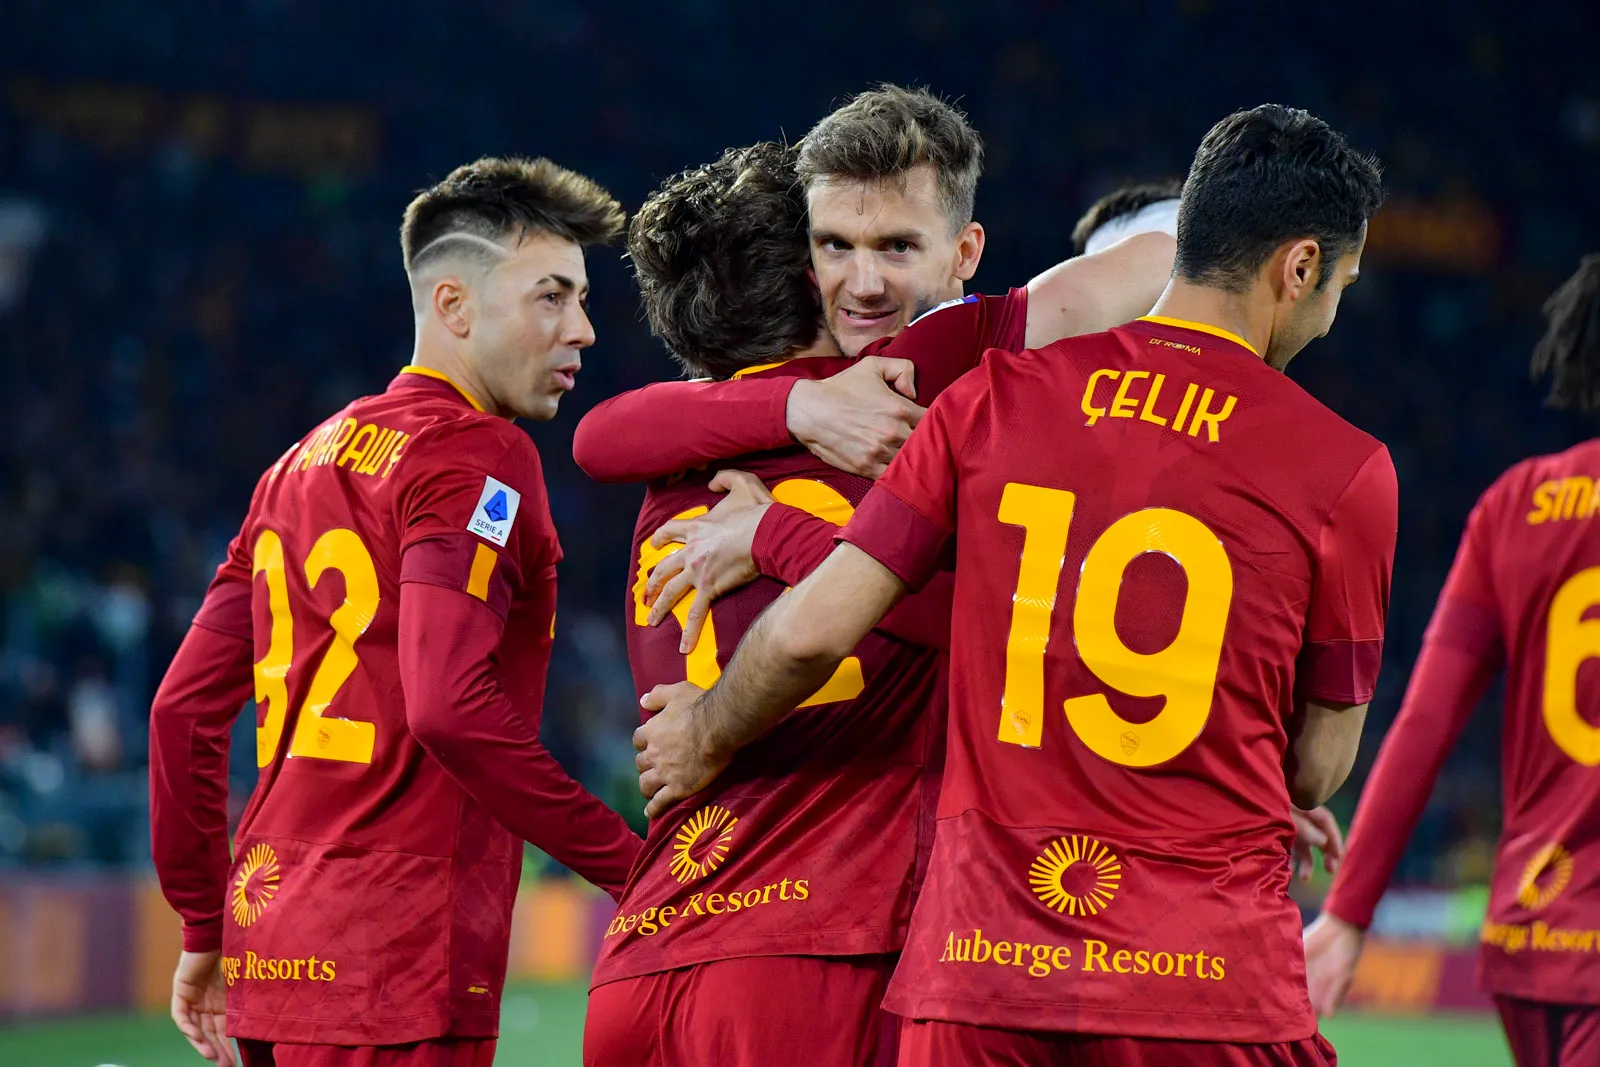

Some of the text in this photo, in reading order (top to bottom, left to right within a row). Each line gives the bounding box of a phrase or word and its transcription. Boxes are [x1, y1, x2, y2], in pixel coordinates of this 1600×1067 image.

[1081, 368, 1238, 443] ÇELIK
[475, 519, 496, 534] SERIE
[997, 482, 1234, 768] 19
[680, 877, 809, 918] Resorts
[244, 951, 336, 981] Resorts
[939, 929, 1226, 980] Auberge Resorts
